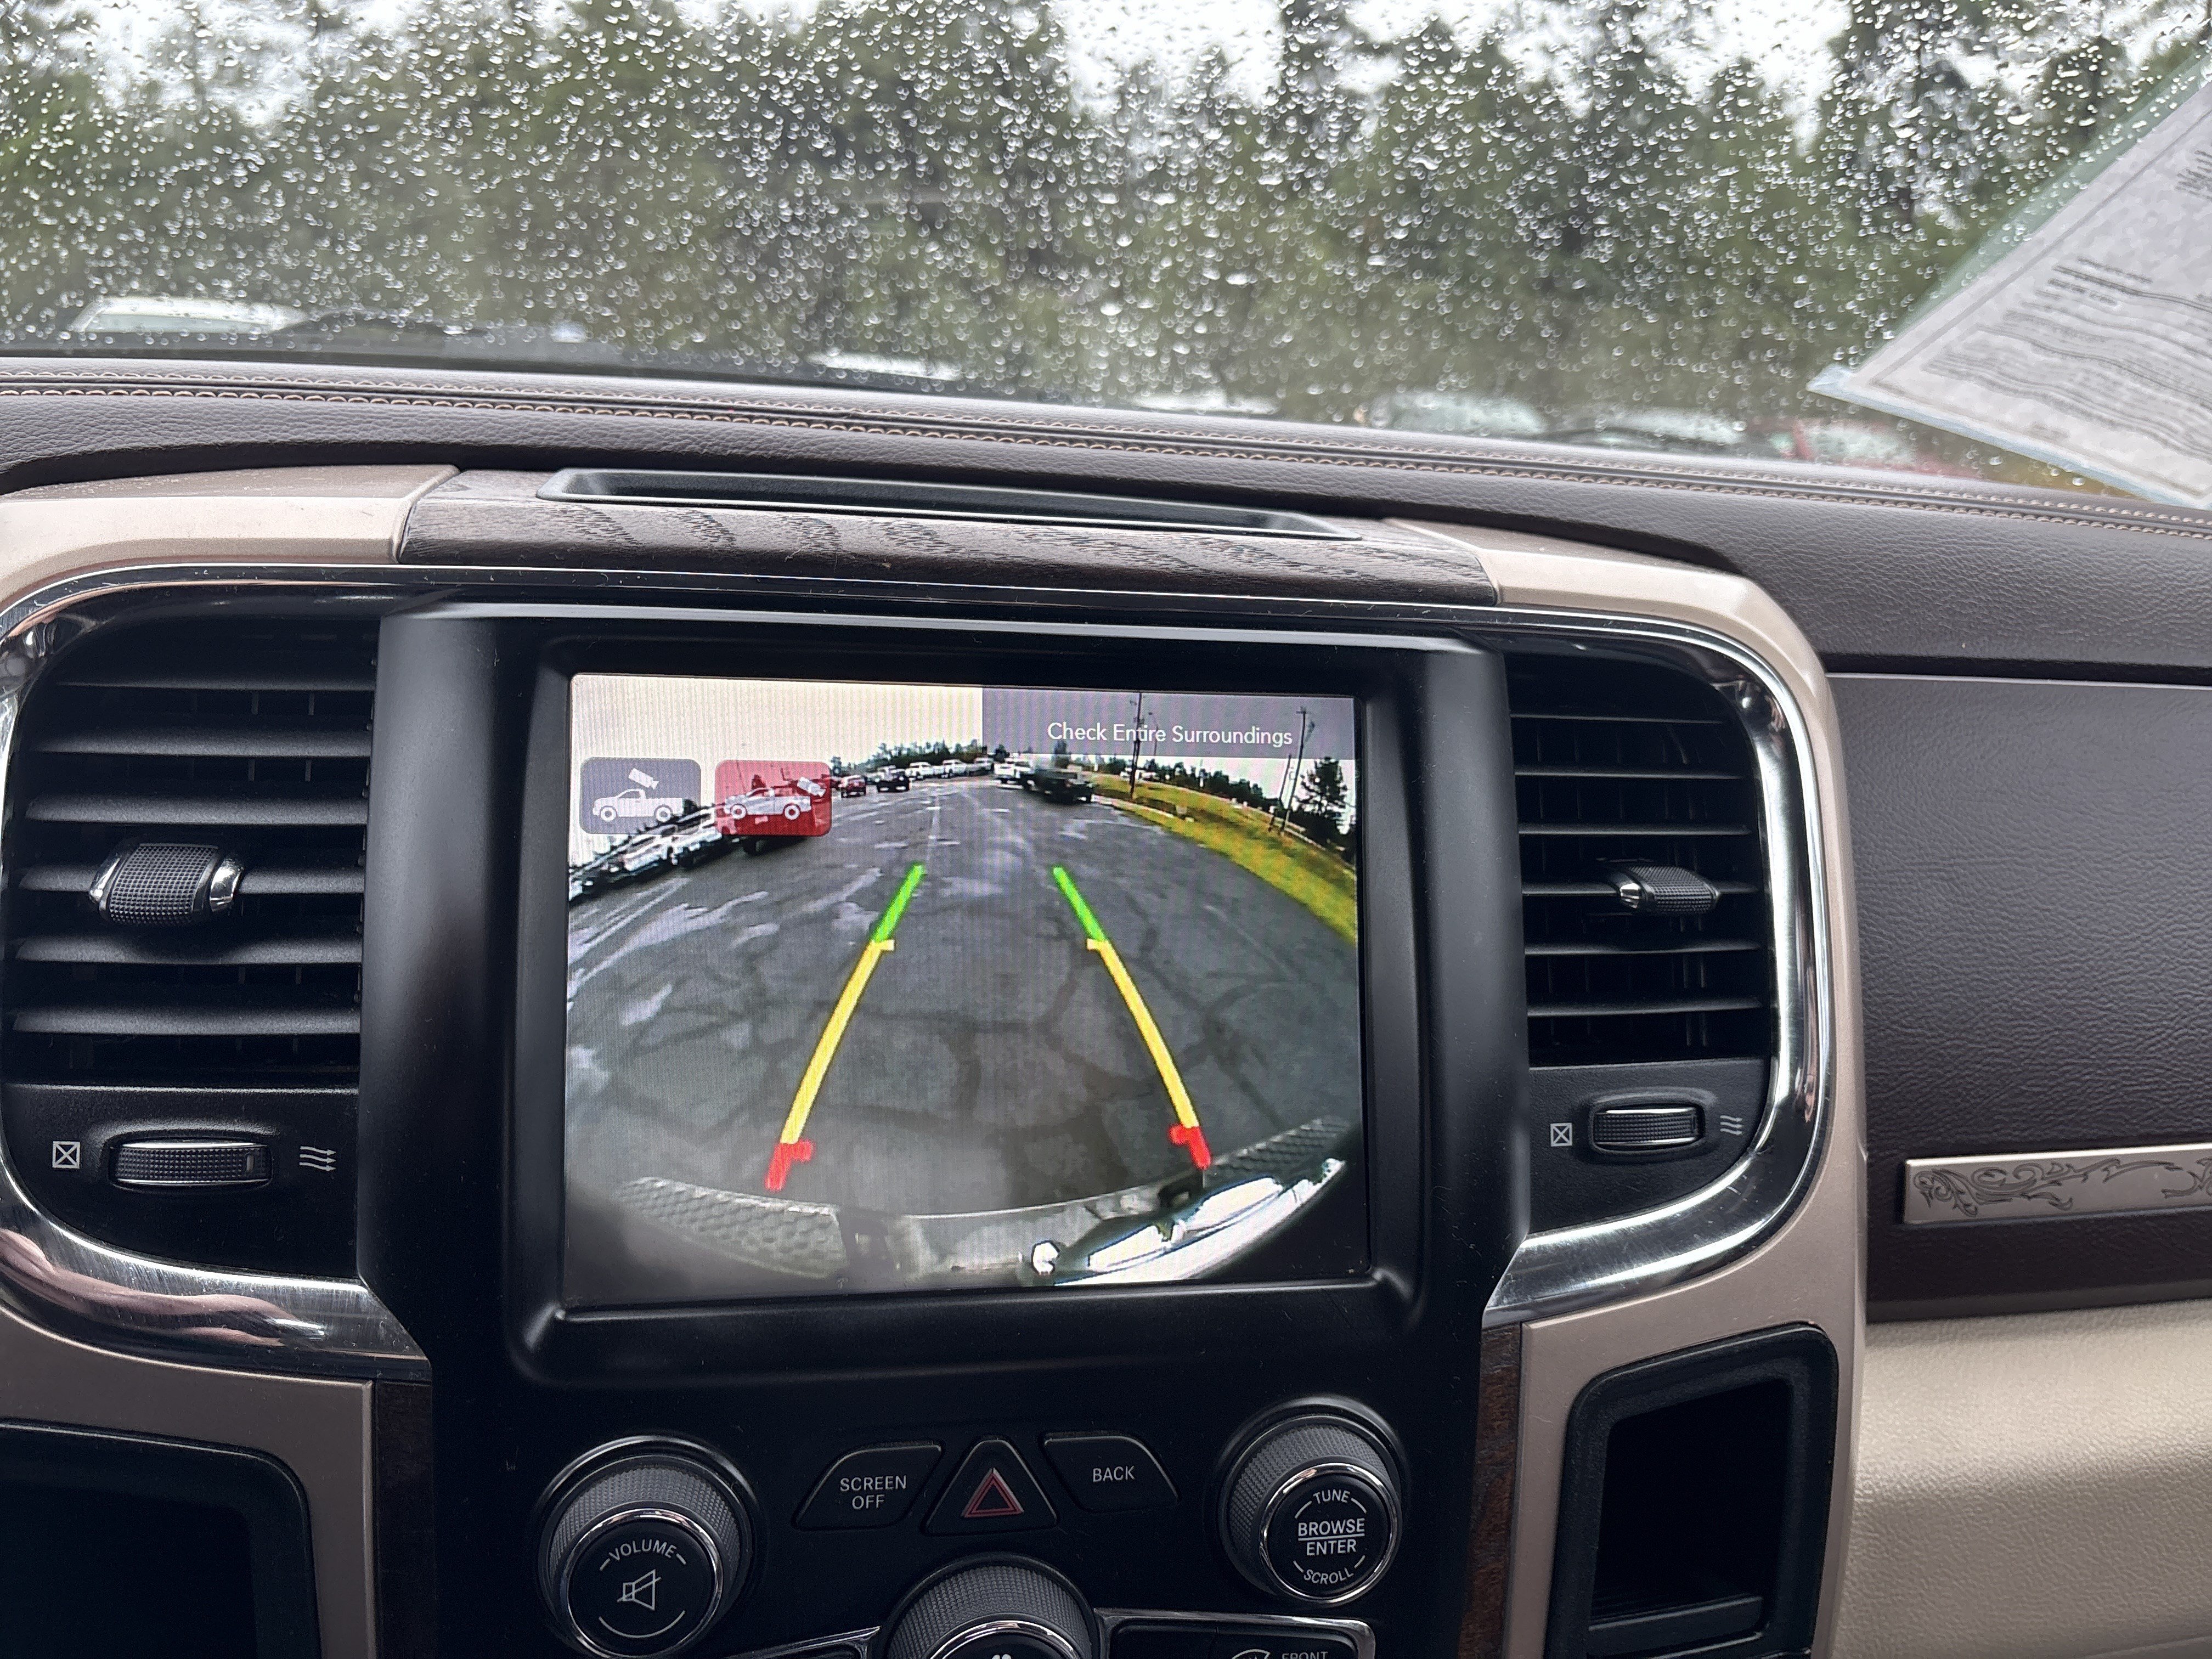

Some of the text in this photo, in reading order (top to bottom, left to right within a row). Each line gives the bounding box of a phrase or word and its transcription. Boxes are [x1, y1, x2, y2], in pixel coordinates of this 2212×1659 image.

[1047, 721, 1293, 747] Check Entire Surroundings
[1093, 1465, 1135, 1482] BACK
[840, 1475, 906, 1492] SCREEN
[852, 1494, 885, 1509] OFF
[1313, 1488, 1351, 1504] TUNE
[1298, 1517, 1365, 1536] BROWSE
[608, 1539, 678, 1561] VOLUME
[1306, 1539, 1357, 1556] ENTER
[1304, 1567, 1354, 1585] SCROLL
